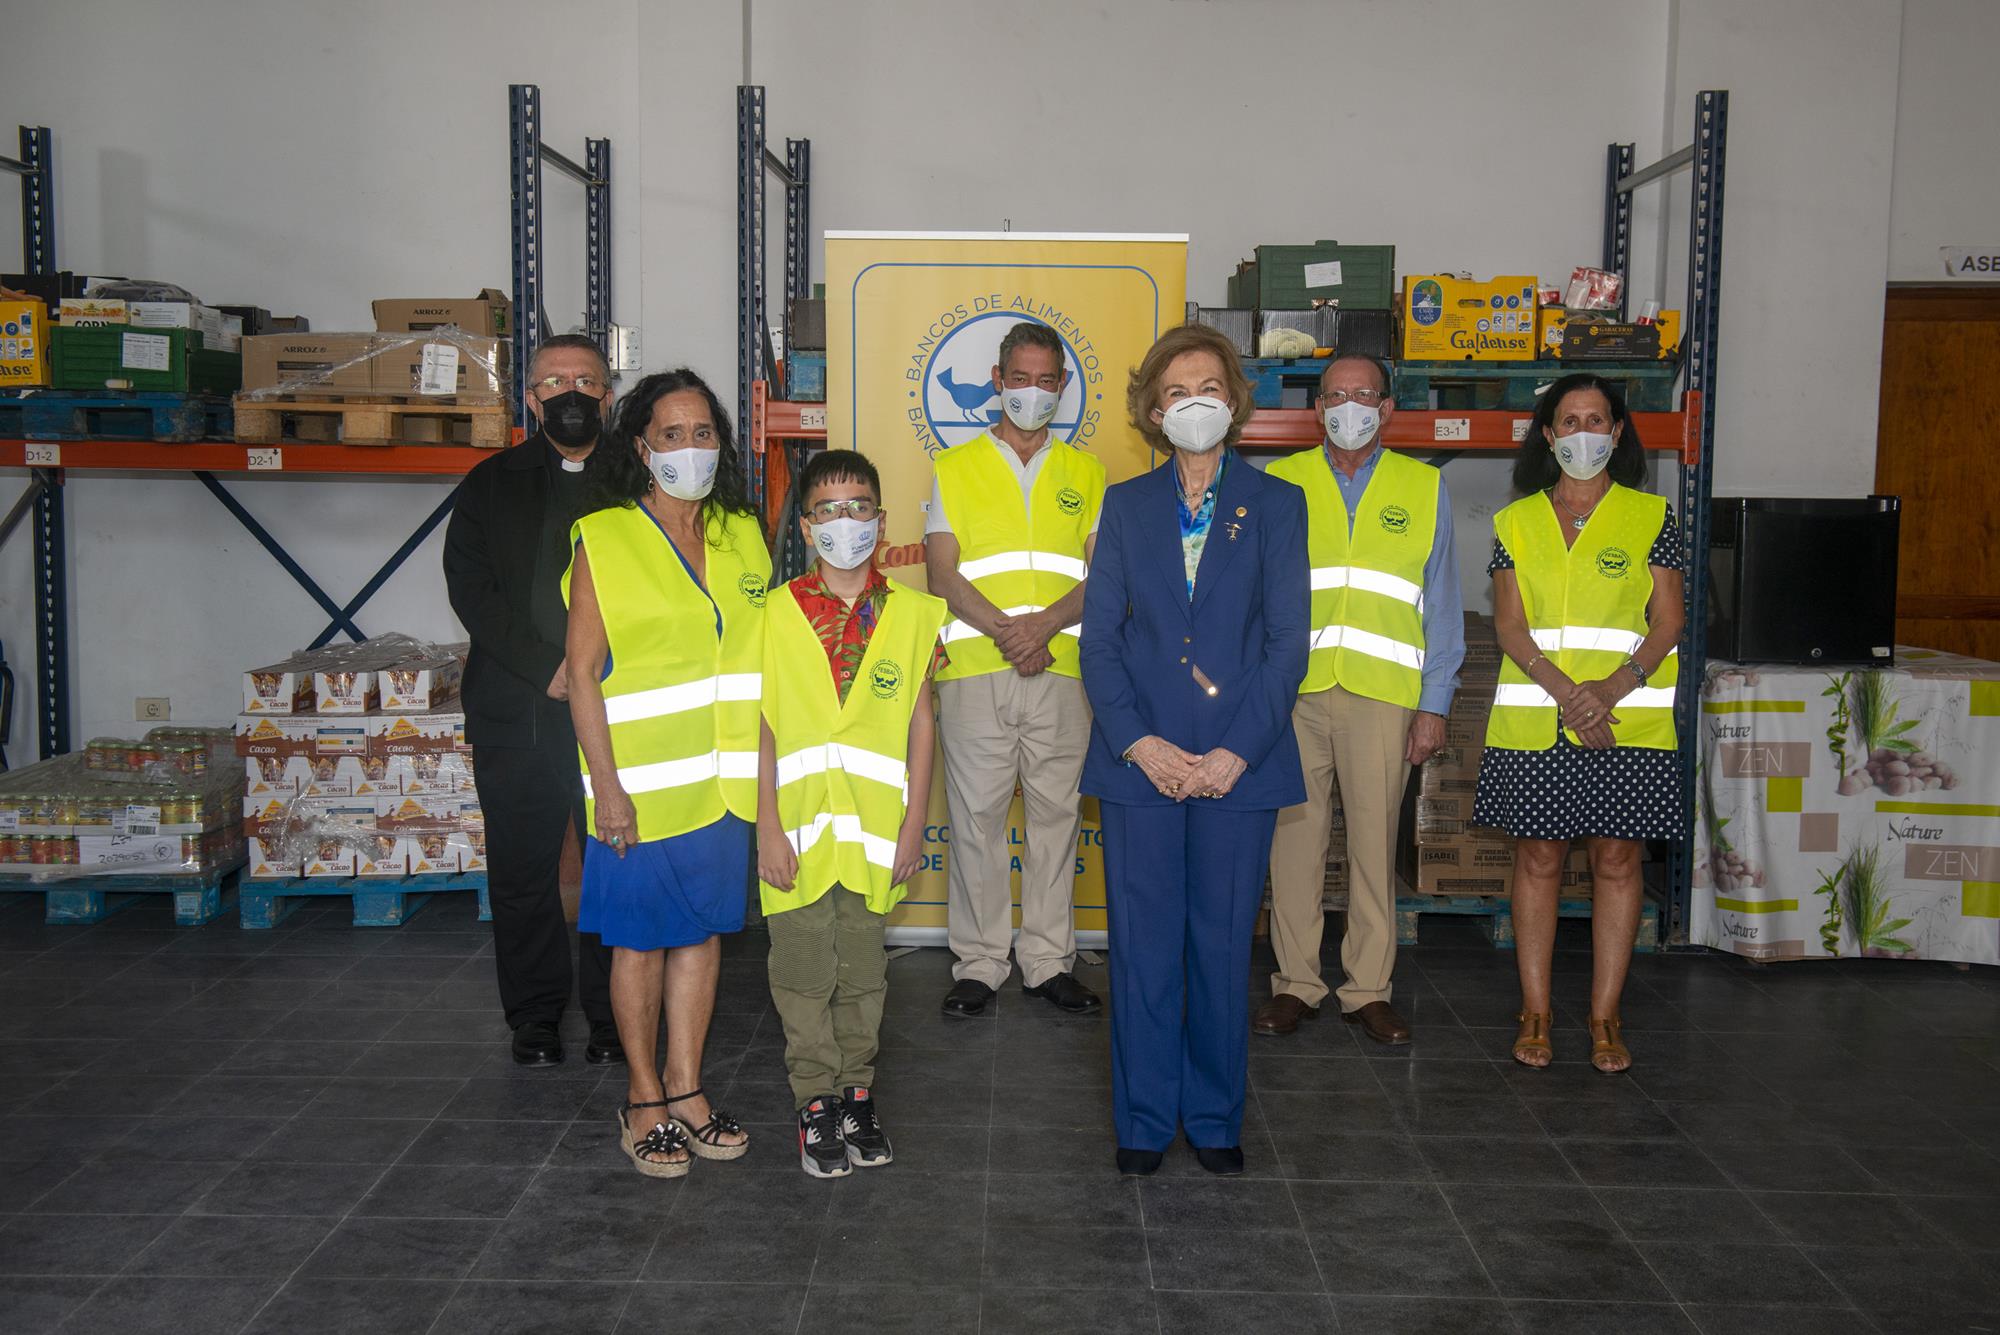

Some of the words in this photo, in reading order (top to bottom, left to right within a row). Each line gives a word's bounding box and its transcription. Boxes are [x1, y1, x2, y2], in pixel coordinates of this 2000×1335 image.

[906, 304, 969, 381] BANCOS
[974, 294, 1003, 312] DE
[1010, 295, 1104, 384] ALIMENTOS
[1450, 330, 1528, 354] Galdense
[282, 346, 319, 354] ARROZ
[801, 415, 825, 425] E1-1
[1435, 426, 1460, 437] E3-1
[26, 451, 53, 462] D1-2
[248, 456, 274, 467] D2-1
[249, 745, 277, 754] Cacao
[386, 744, 415, 753] Cacao
[1738, 747, 1784, 773] ZEN
[1887, 816, 1943, 841] Nature
[1424, 852, 1456, 861] ISABEL
[1925, 850, 1979, 877] ZEN
[1722, 914, 1759, 939] Nature
